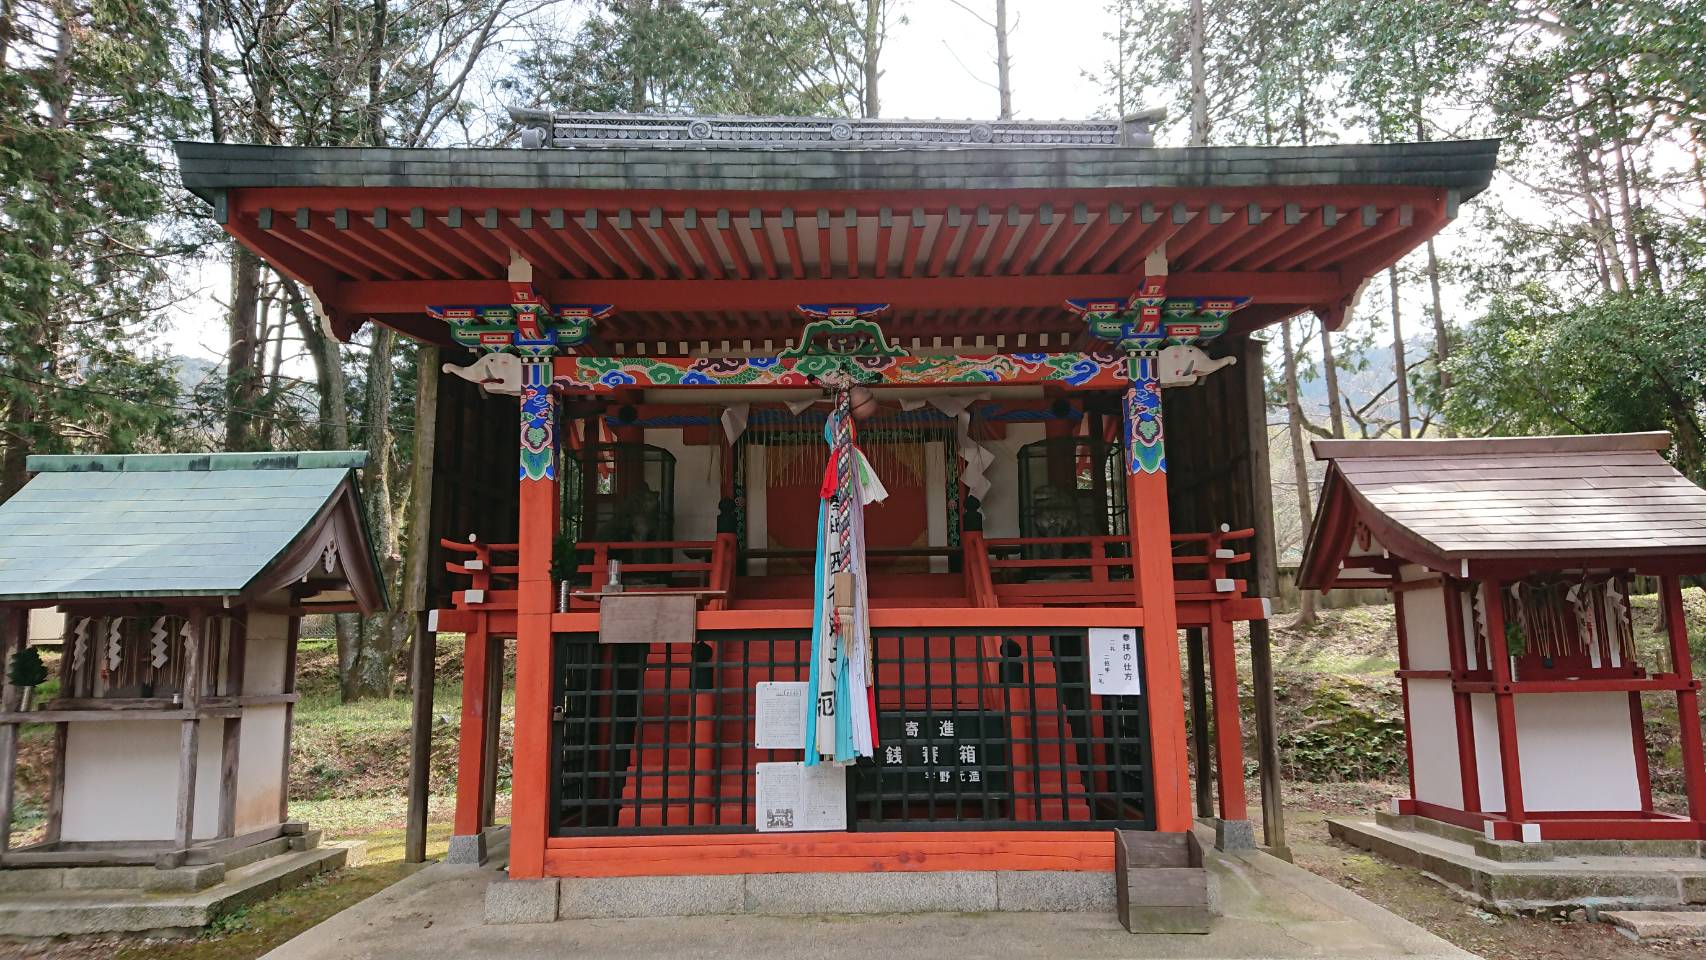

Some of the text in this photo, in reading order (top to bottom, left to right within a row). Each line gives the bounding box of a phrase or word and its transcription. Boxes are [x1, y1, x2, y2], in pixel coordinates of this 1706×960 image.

[1123, 633, 1132, 681] 参拝の仕方
[905, 720, 954, 737] 寄進
